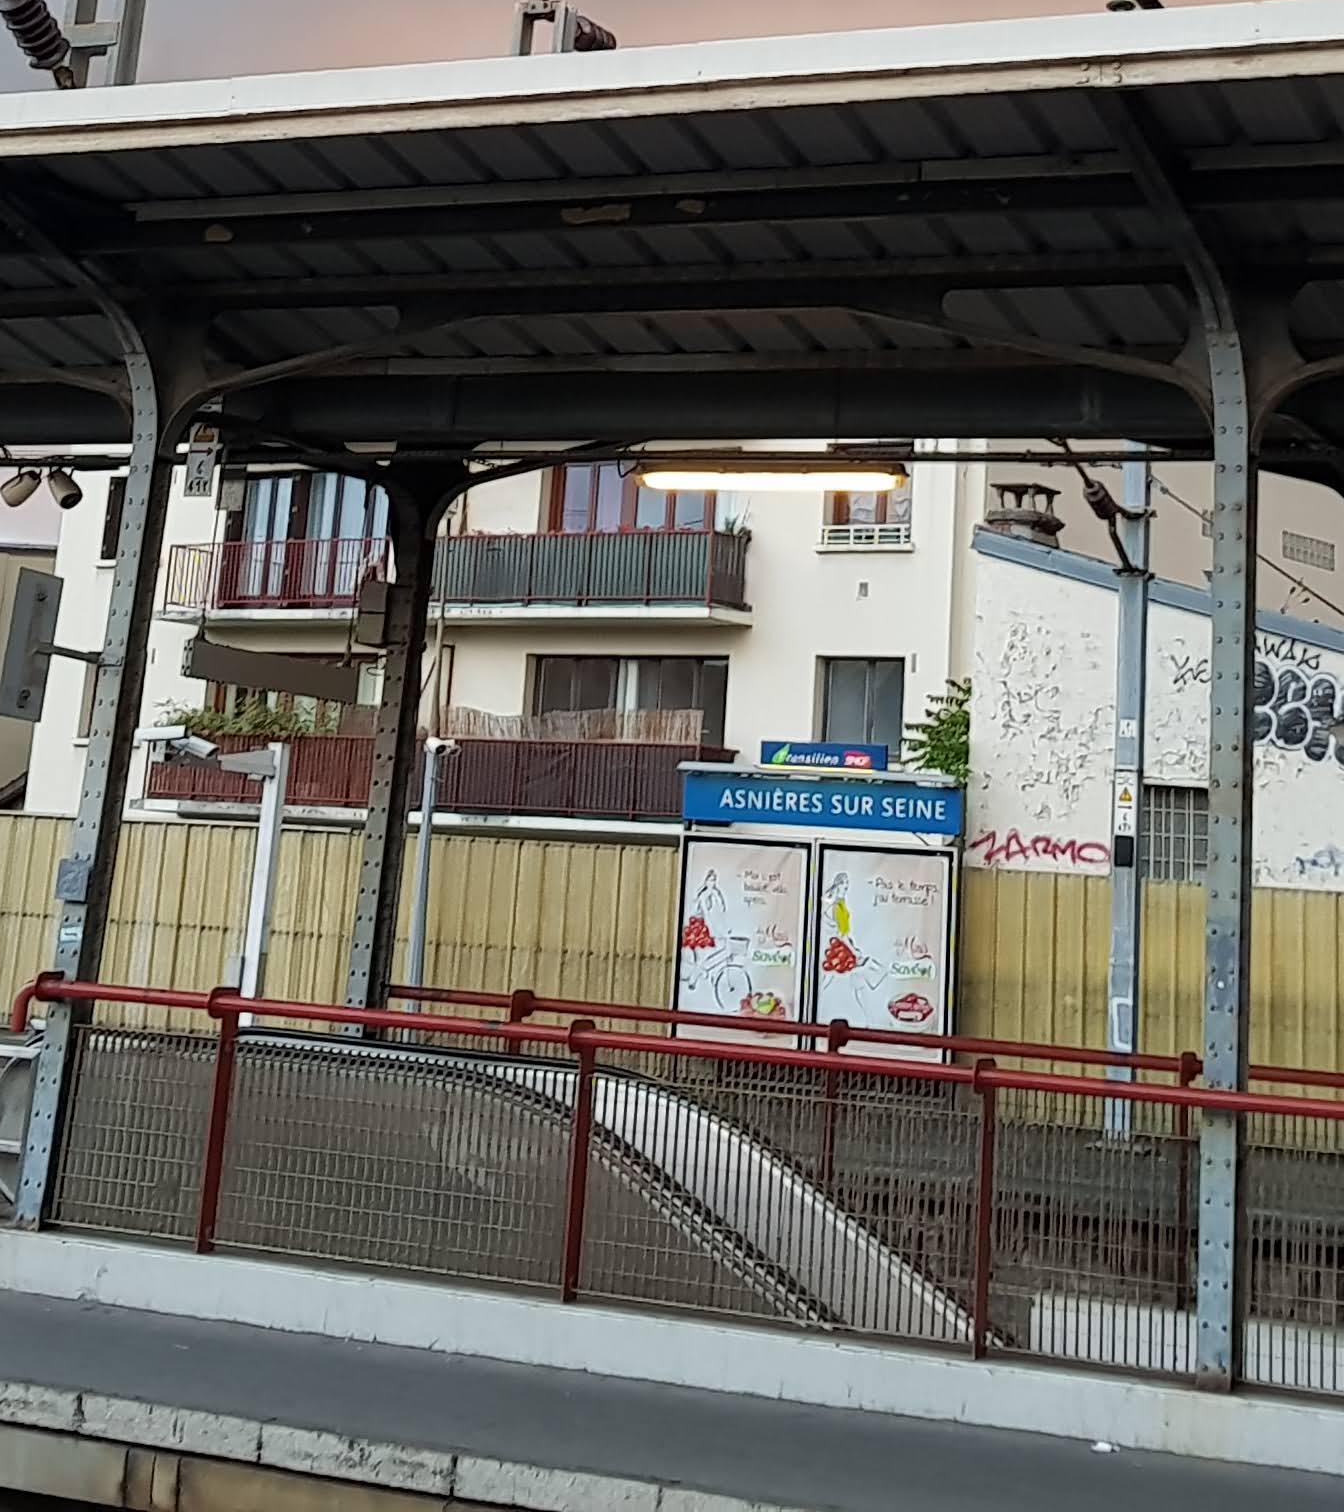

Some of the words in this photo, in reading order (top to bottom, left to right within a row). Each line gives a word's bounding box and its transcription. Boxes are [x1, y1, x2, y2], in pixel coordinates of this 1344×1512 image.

[719, 787, 823, 813] ASNIÈRES
[830, 794, 874, 816] SUR
[881, 797, 946, 821] SEINE
